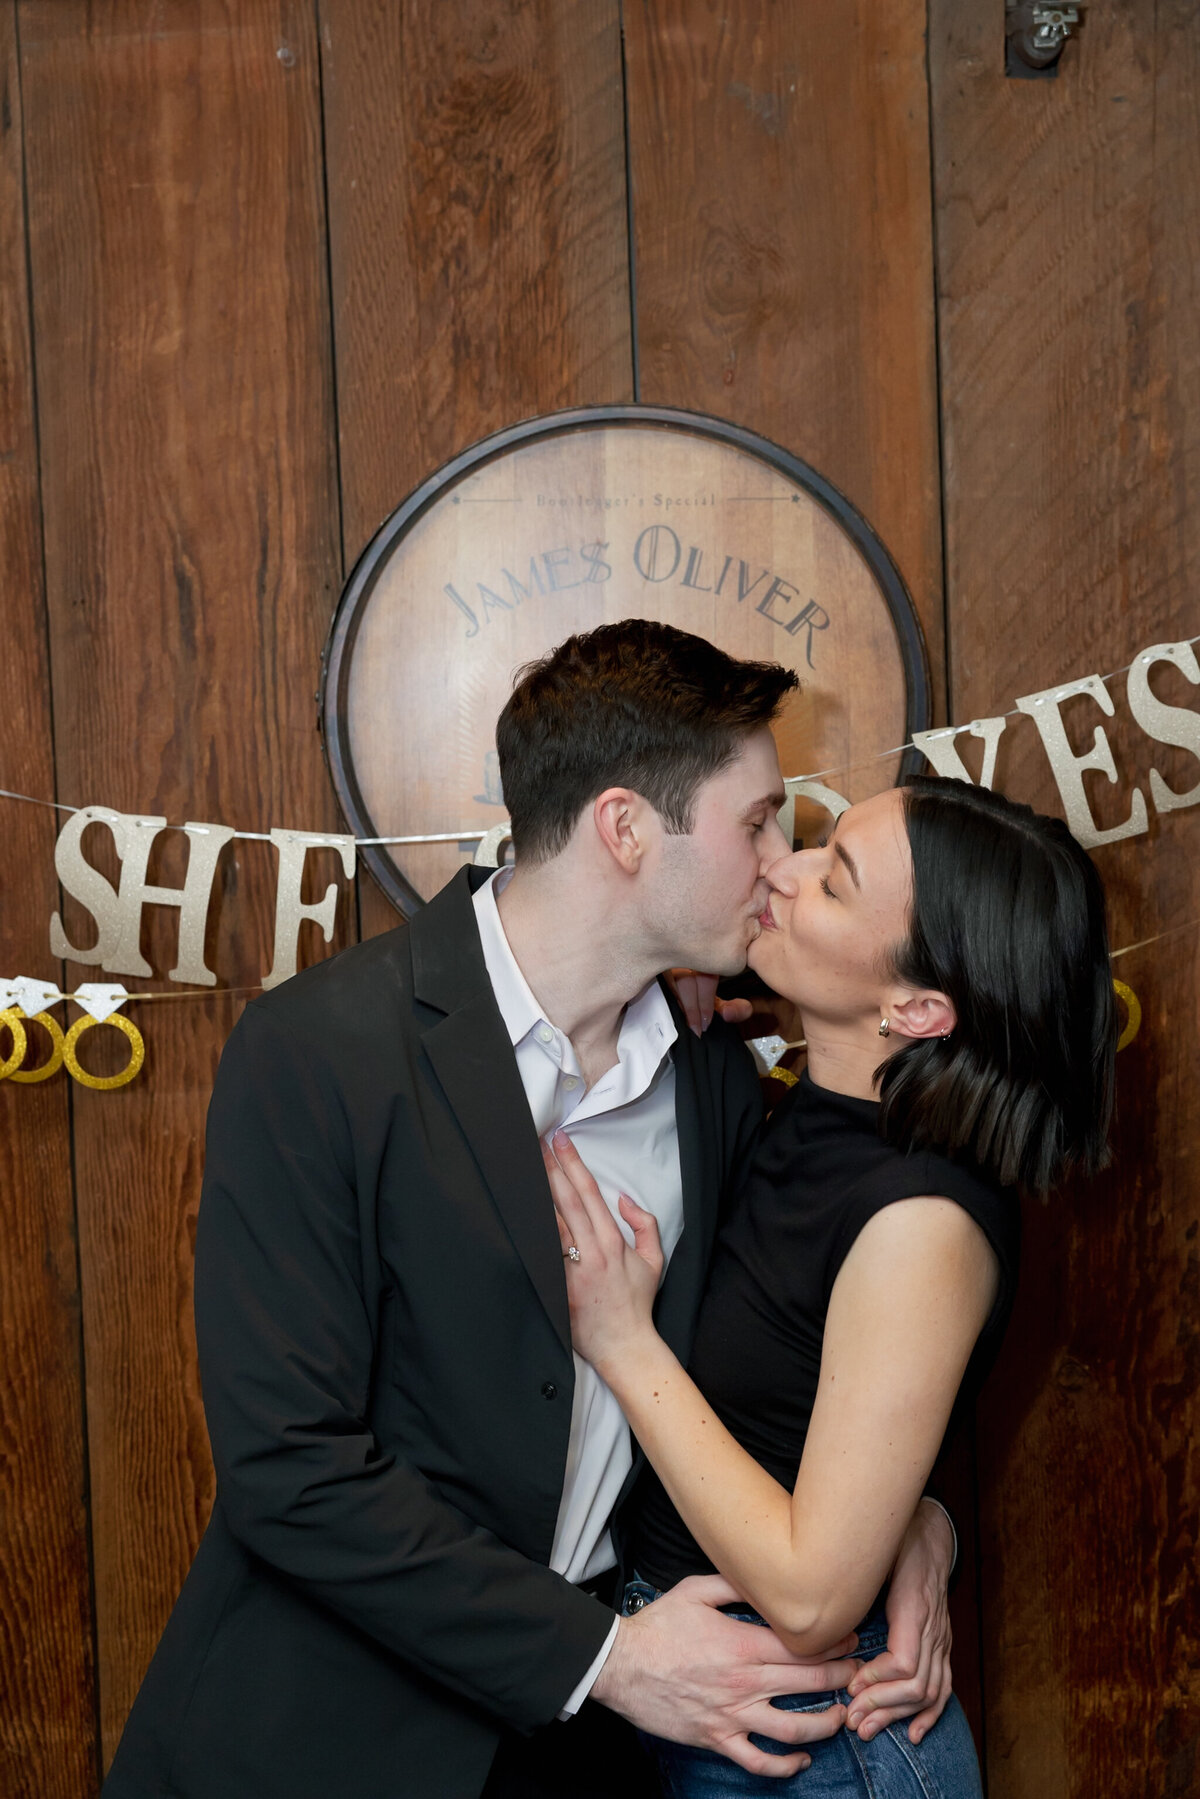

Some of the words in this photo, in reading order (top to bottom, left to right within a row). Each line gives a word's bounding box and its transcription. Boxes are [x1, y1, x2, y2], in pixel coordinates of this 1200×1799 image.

[654, 493, 715, 511] Special
[443, 541, 613, 639] JAMES
[632, 524, 831, 671] OLIVER
